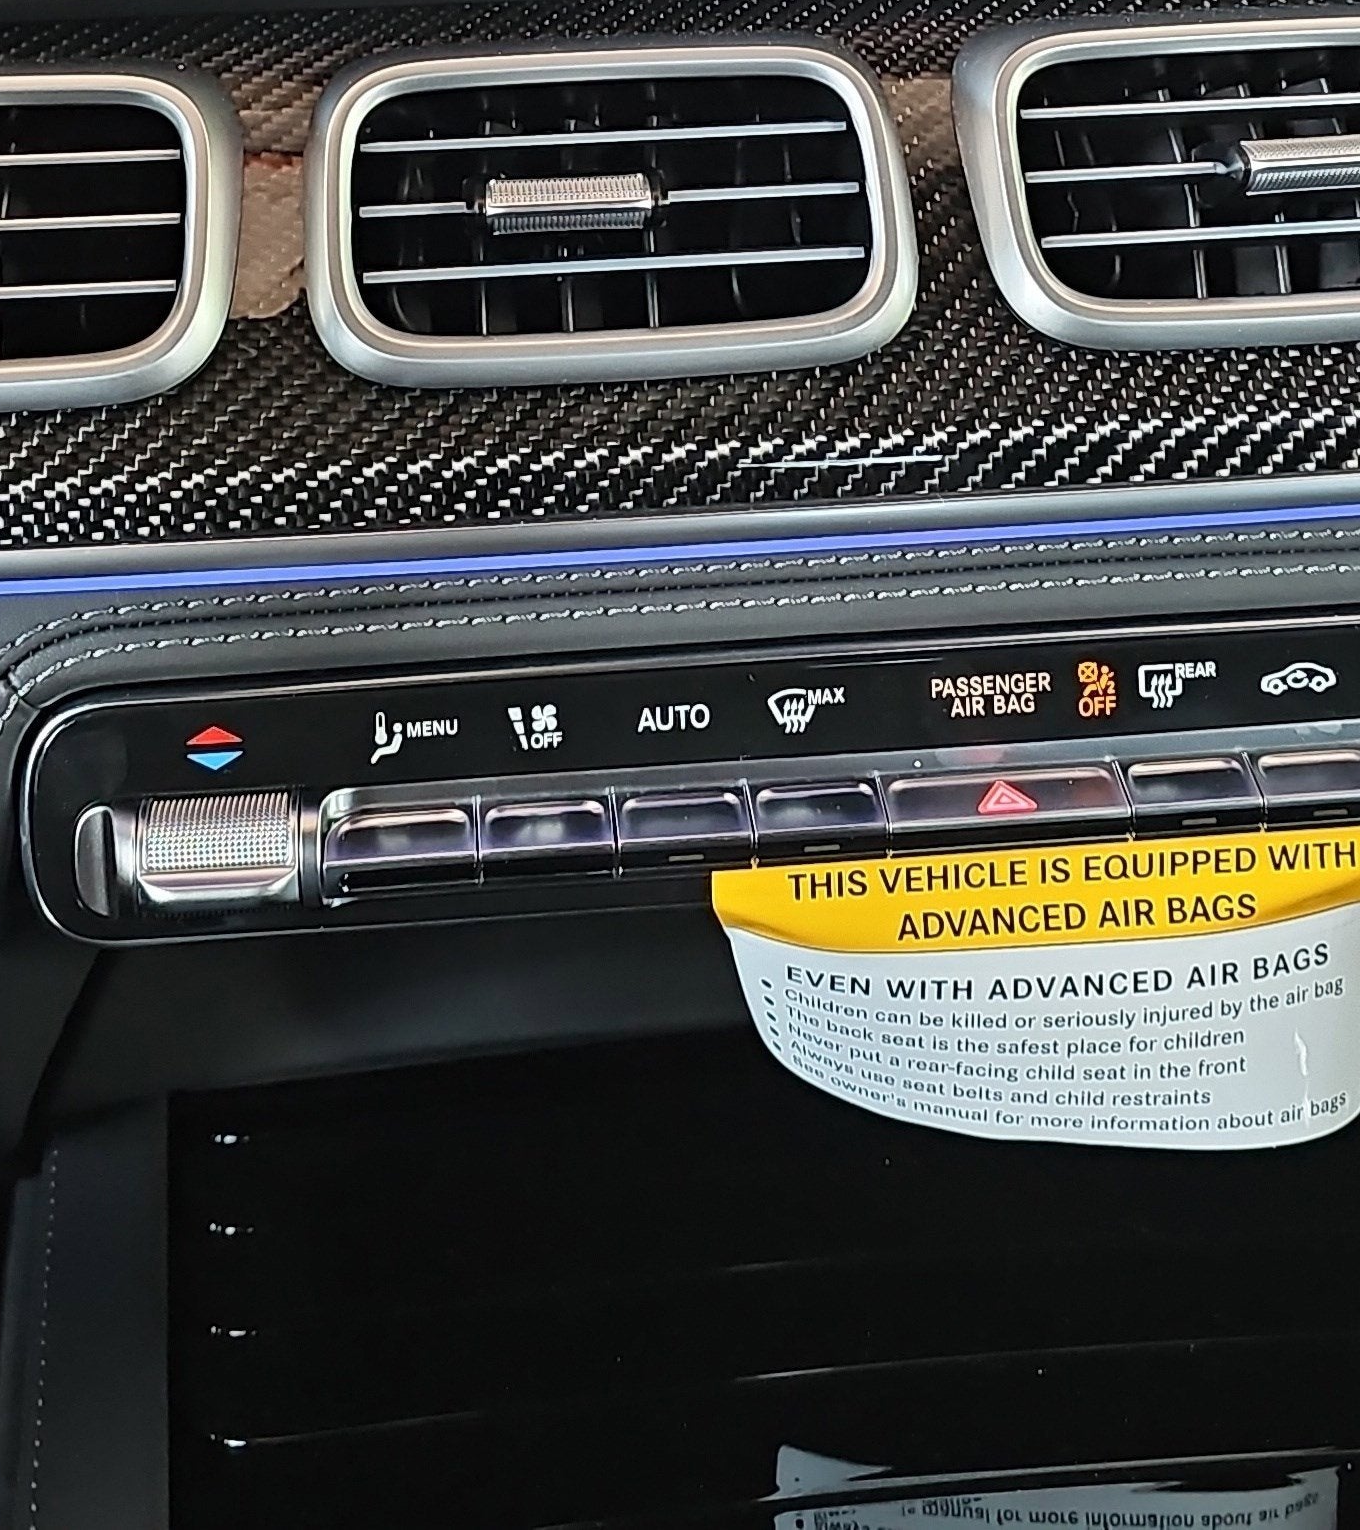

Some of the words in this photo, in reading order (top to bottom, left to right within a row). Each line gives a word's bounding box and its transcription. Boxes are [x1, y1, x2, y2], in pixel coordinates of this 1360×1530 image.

[930, 672, 1051, 700] PASSENGER
[1174, 661, 1216, 680] REAR
[807, 686, 846, 706] MAX
[950, 695, 987, 718] AIR
[993, 692, 1037, 715] BAG
[1078, 695, 1117, 717] OFF
[406, 717, 459, 740] MENU
[637, 704, 712, 733] AUTO
[530, 731, 564, 749] OFF
[787, 870, 868, 902] THIS
[878, 858, 1029, 895] VEHICLE
[1040, 855, 1071, 885] IS
[1082, 846, 1258, 884] EQUIPPED
[1268, 839, 1358, 871] WITH
[897, 903, 1086, 941] ADVANCED
[1098, 899, 1157, 929] AIR
[1167, 892, 1258, 925] BAGS
[786, 965, 871, 997] EVEN
[886, 978, 974, 1001] WITH
[988, 969, 1174, 1001] ADVANCED
[1186, 961, 1240, 990] AIR
[1252, 941, 1330, 981] BAGS
[785, 987, 869, 1020] Children
[875, 1010, 912, 1026] can
[919, 1008, 944, 1029] be
[951, 1009, 1007, 1030] killed
[1014, 1015, 1037, 1029] or
[1043, 1008, 1137, 1032] seriously
[1143, 1000, 1214, 1028] injured
[1220, 998, 1243, 1020] by
[1249, 994, 1280, 1014] the
[1285, 985, 1309, 1006] air
[1314, 976, 1344, 998] bag
[786, 1003, 821, 1028] The
[827, 1021, 875, 1043] back
[881, 1034, 926, 1051] seat
[932, 1035, 949, 1052] is
[956, 1037, 990, 1055] the
[996, 1038, 1060, 1057] safest
[1066, 1036, 1122, 1059] place
[1129, 1035, 1158, 1054] for
[1163, 1029, 1245, 1052] children
[788, 1022, 844, 1052] Never
[849, 1044, 883, 1065] put
[889, 1055, 901, 1068] a
[907, 1056, 1020, 1083] rear-facing
[1026, 1062, 1075, 1081] child
[1082, 1063, 1127, 1082] seat
[1133, 1062, 1152, 1081] in
[1158, 1060, 1192, 1080] the
[1198, 1055, 1247, 1078] front
[789, 1038, 855, 1076] Always
[861, 1069, 896, 1086] use
[902, 1077, 947, 1096] seat
[953, 1082, 1004, 1102] belts
[1010, 1088, 1048, 1106] and
[1055, 1085, 1105, 1107] child
[1112, 1087, 1212, 1107] restraints
[830, 1076, 907, 1108] owner's
[913, 1100, 988, 1123] manual
[995, 1108, 1025, 1126] for
[1031, 1114, 1084, 1130] more
[1090, 1114, 1210, 1132] information
[1216, 1110, 1275, 1130] about
[1281, 1104, 1305, 1123] air
[1310, 1091, 1348, 1117] bags
